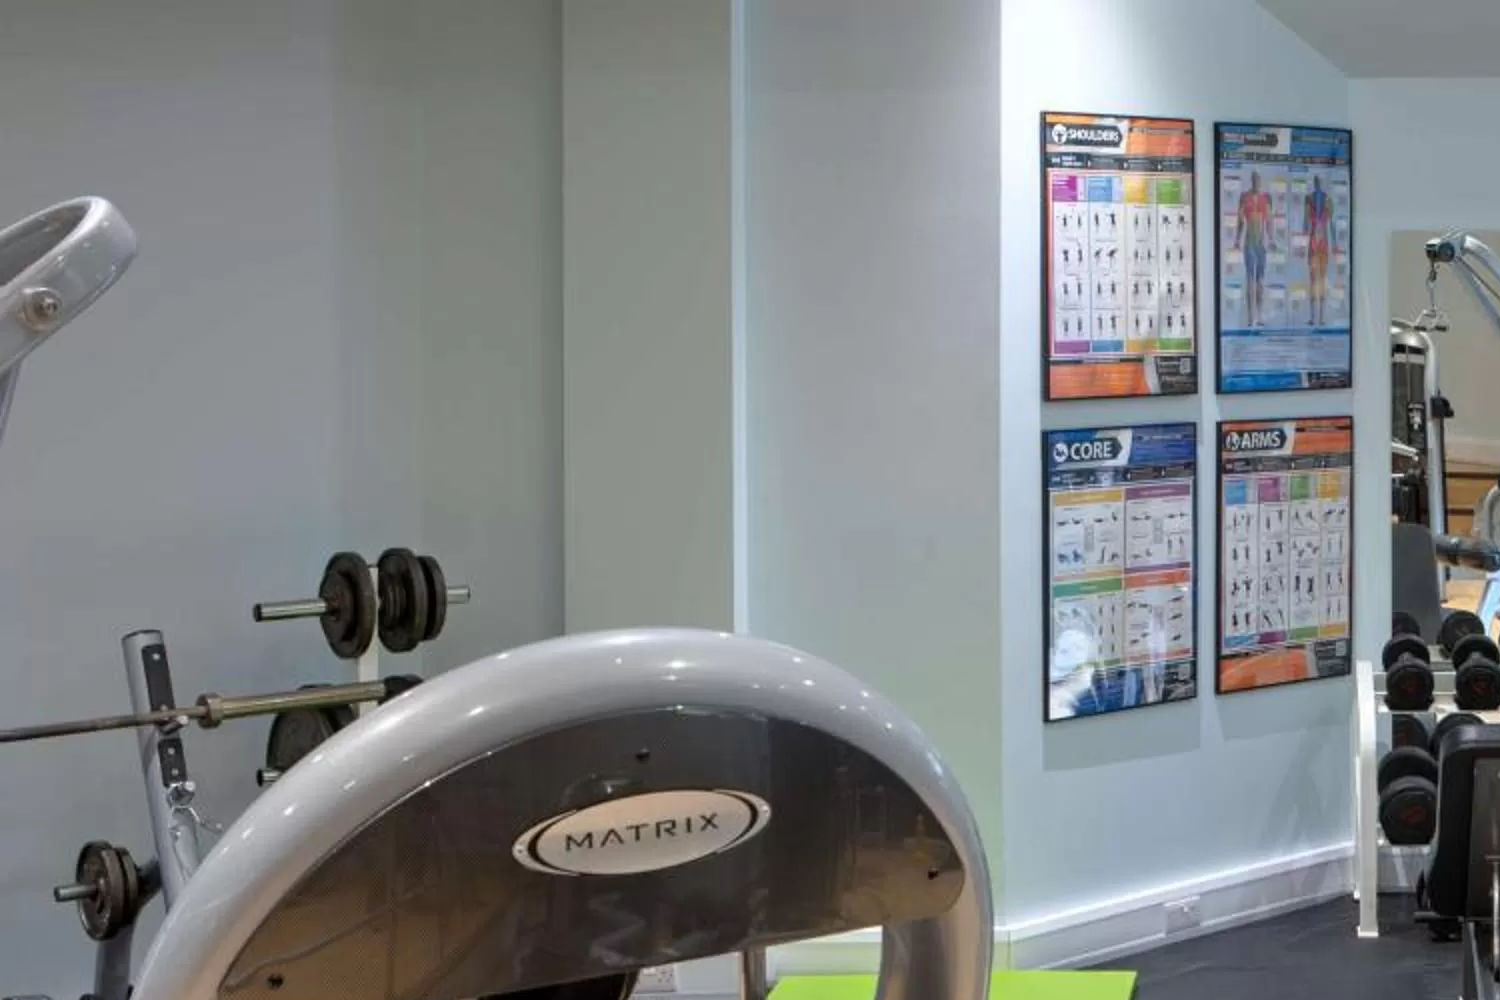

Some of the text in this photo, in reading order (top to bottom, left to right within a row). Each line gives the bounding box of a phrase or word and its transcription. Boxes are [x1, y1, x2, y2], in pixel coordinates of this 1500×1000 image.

[1067, 127, 1120, 143] SHOULDERS
[1241, 431, 1281, 449] ARMS
[1070, 441, 1112, 460] CORE
[565, 812, 720, 853] MATRIX
